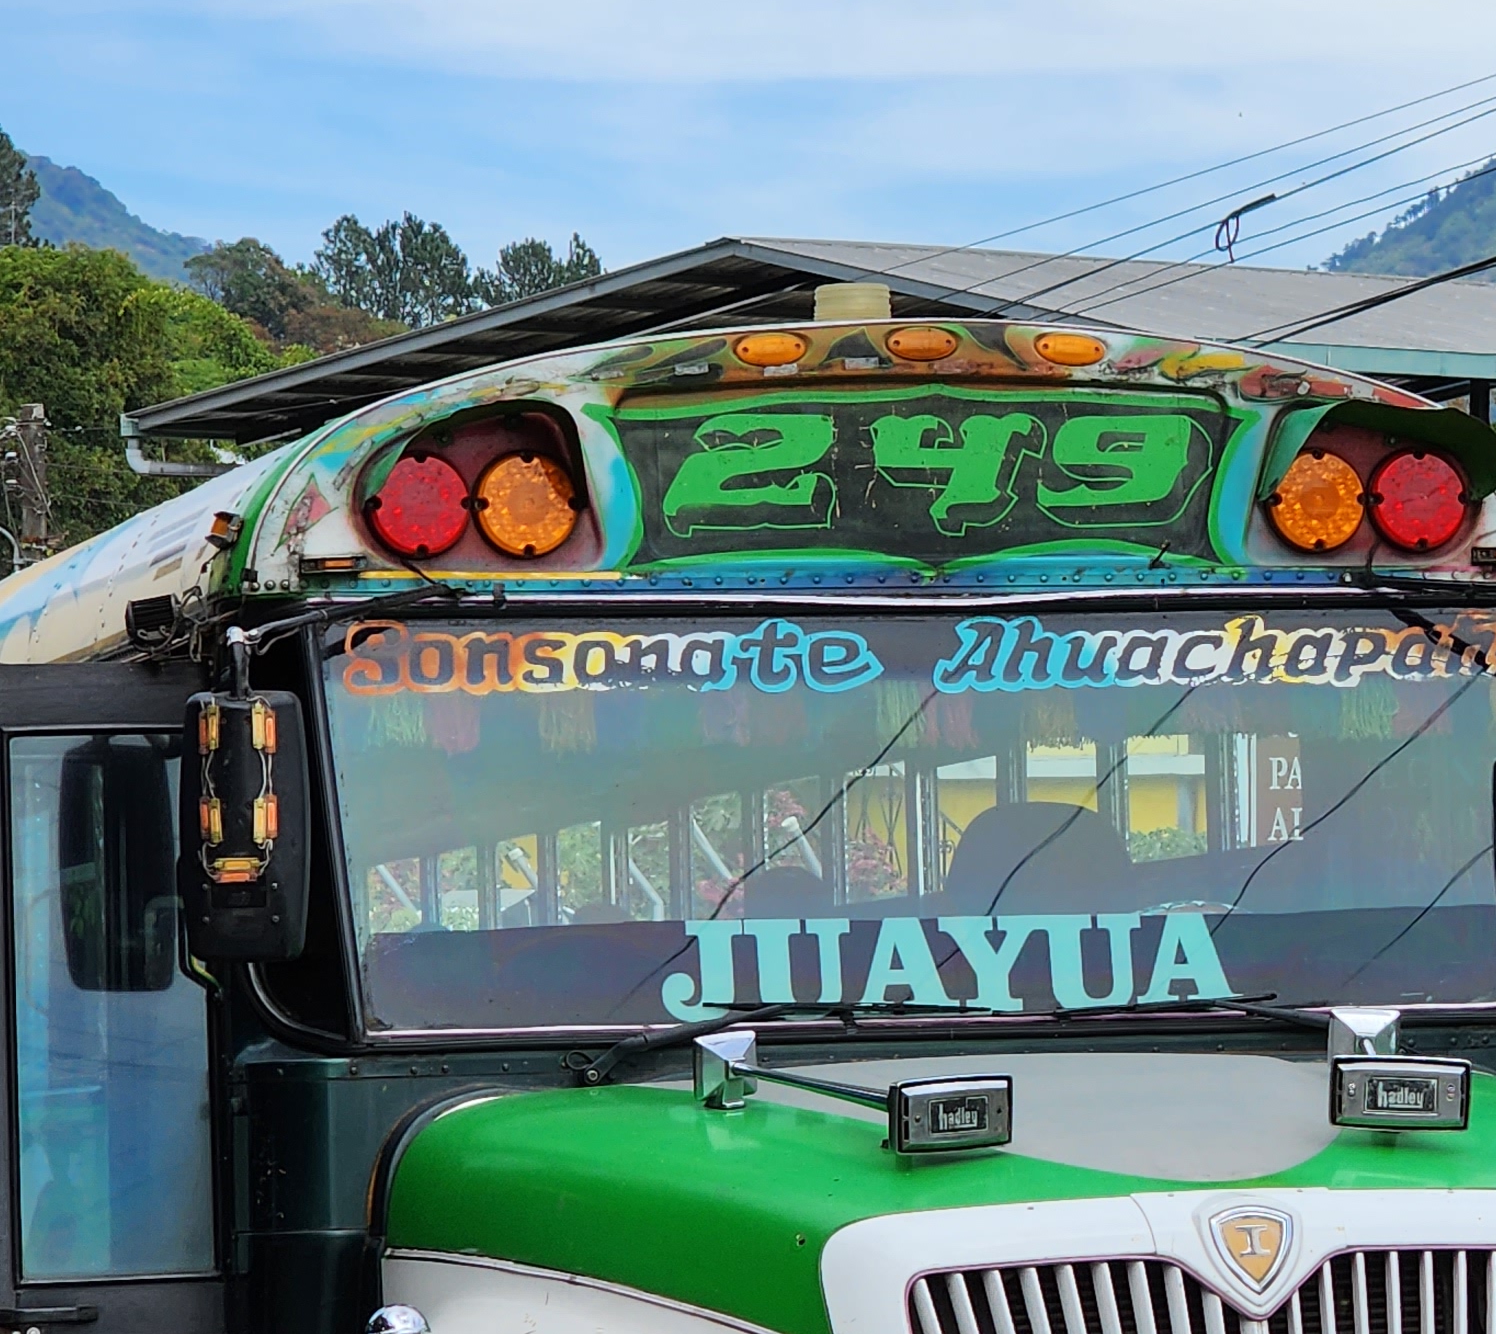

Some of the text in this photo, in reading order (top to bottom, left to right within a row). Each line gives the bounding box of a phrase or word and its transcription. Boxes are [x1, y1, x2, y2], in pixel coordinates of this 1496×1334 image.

[663, 413, 1212, 537] 249
[343, 618, 885, 696] Sonsonate
[661, 913, 1244, 1023] JUAYUA
[938, 1103, 978, 1130] hadley
[1377, 1081, 1425, 1109] hadley
